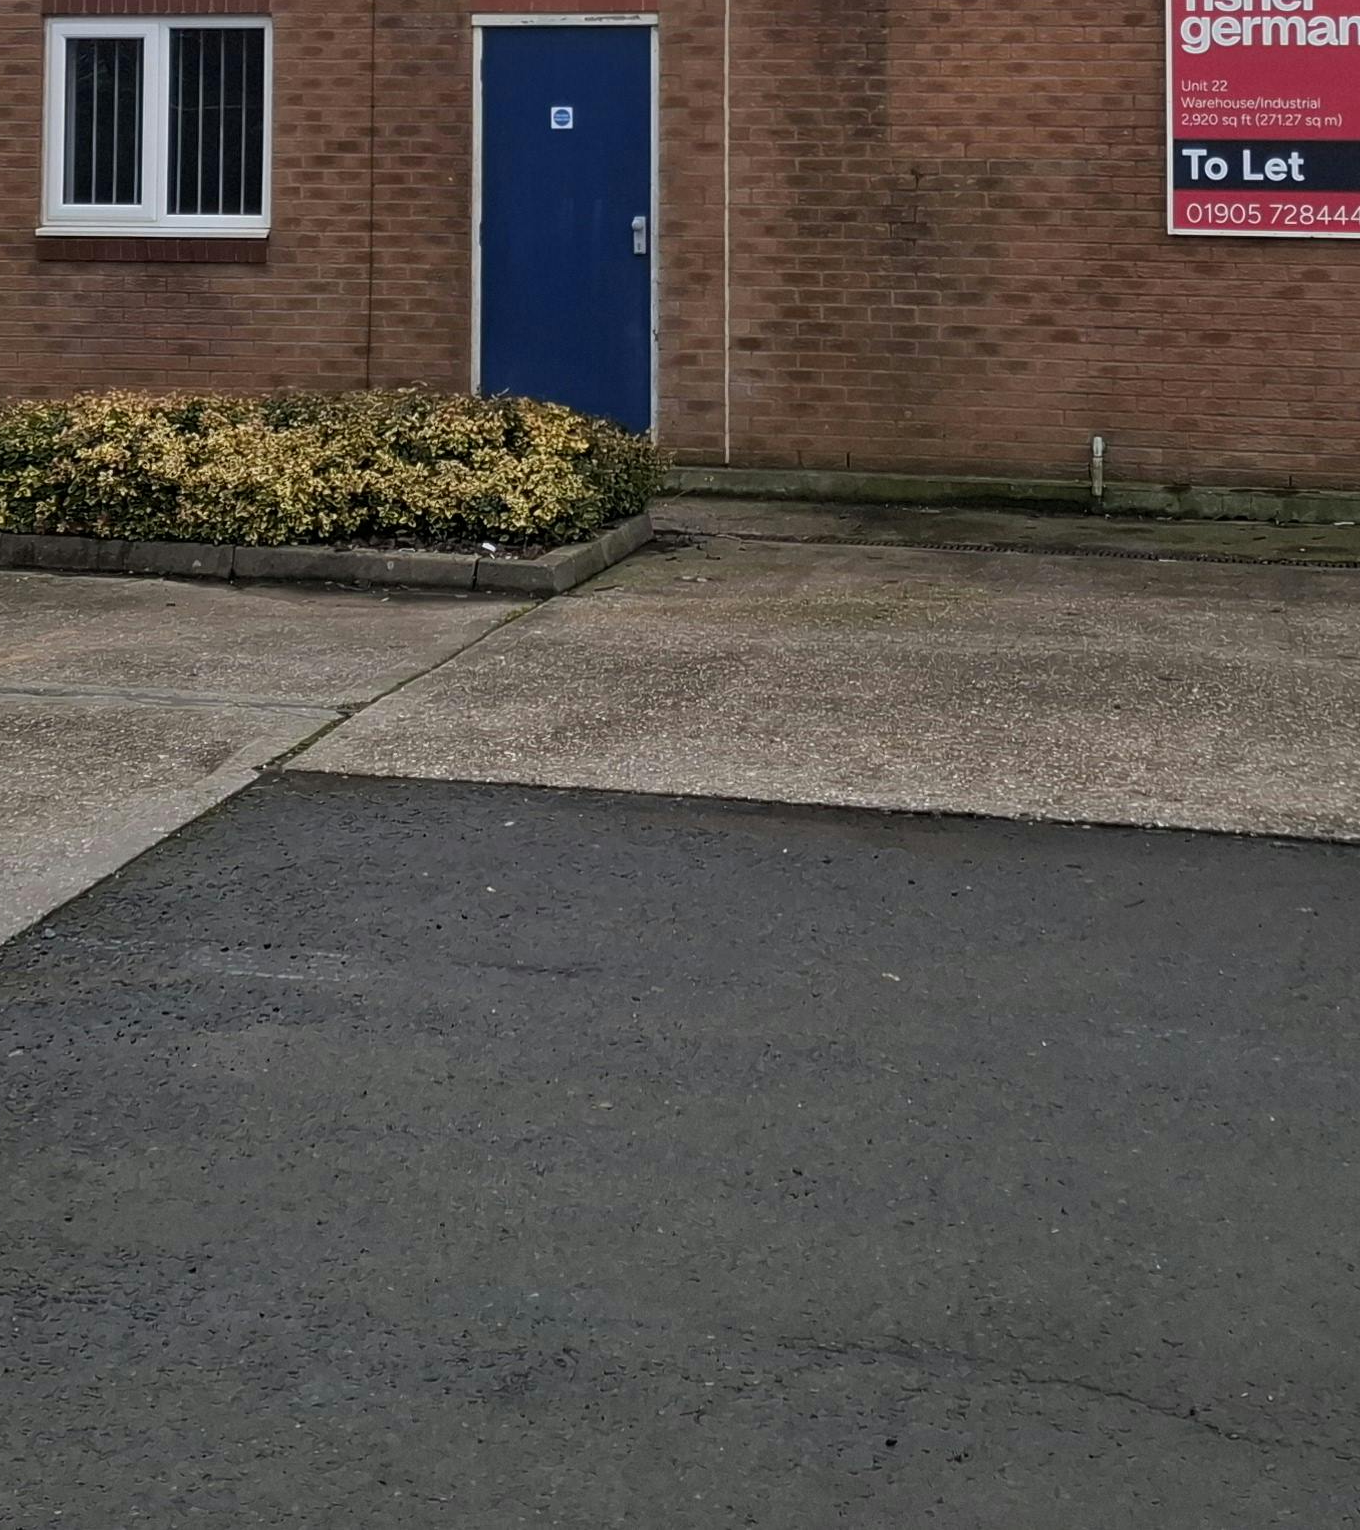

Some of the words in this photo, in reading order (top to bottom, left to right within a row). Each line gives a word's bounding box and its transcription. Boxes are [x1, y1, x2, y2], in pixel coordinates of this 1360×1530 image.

[1181, 80, 1208, 92] Unit
[1211, 80, 1228, 92] 22
[1181, 97, 1321, 110] Warehouse/Industrial
[1181, 113, 1218, 127] 2,920
[1221, 117, 1238, 128] sq
[1241, 114, 1252, 126] ft
[1255, 114, 1302, 127] (271.27
[1305, 117, 1321, 128] sq
[1324, 114, 1343, 128] m)
[1181, 149, 1228, 181] To
[1242, 149, 1306, 182] Let
[1186, 203, 1262, 224] 01905
